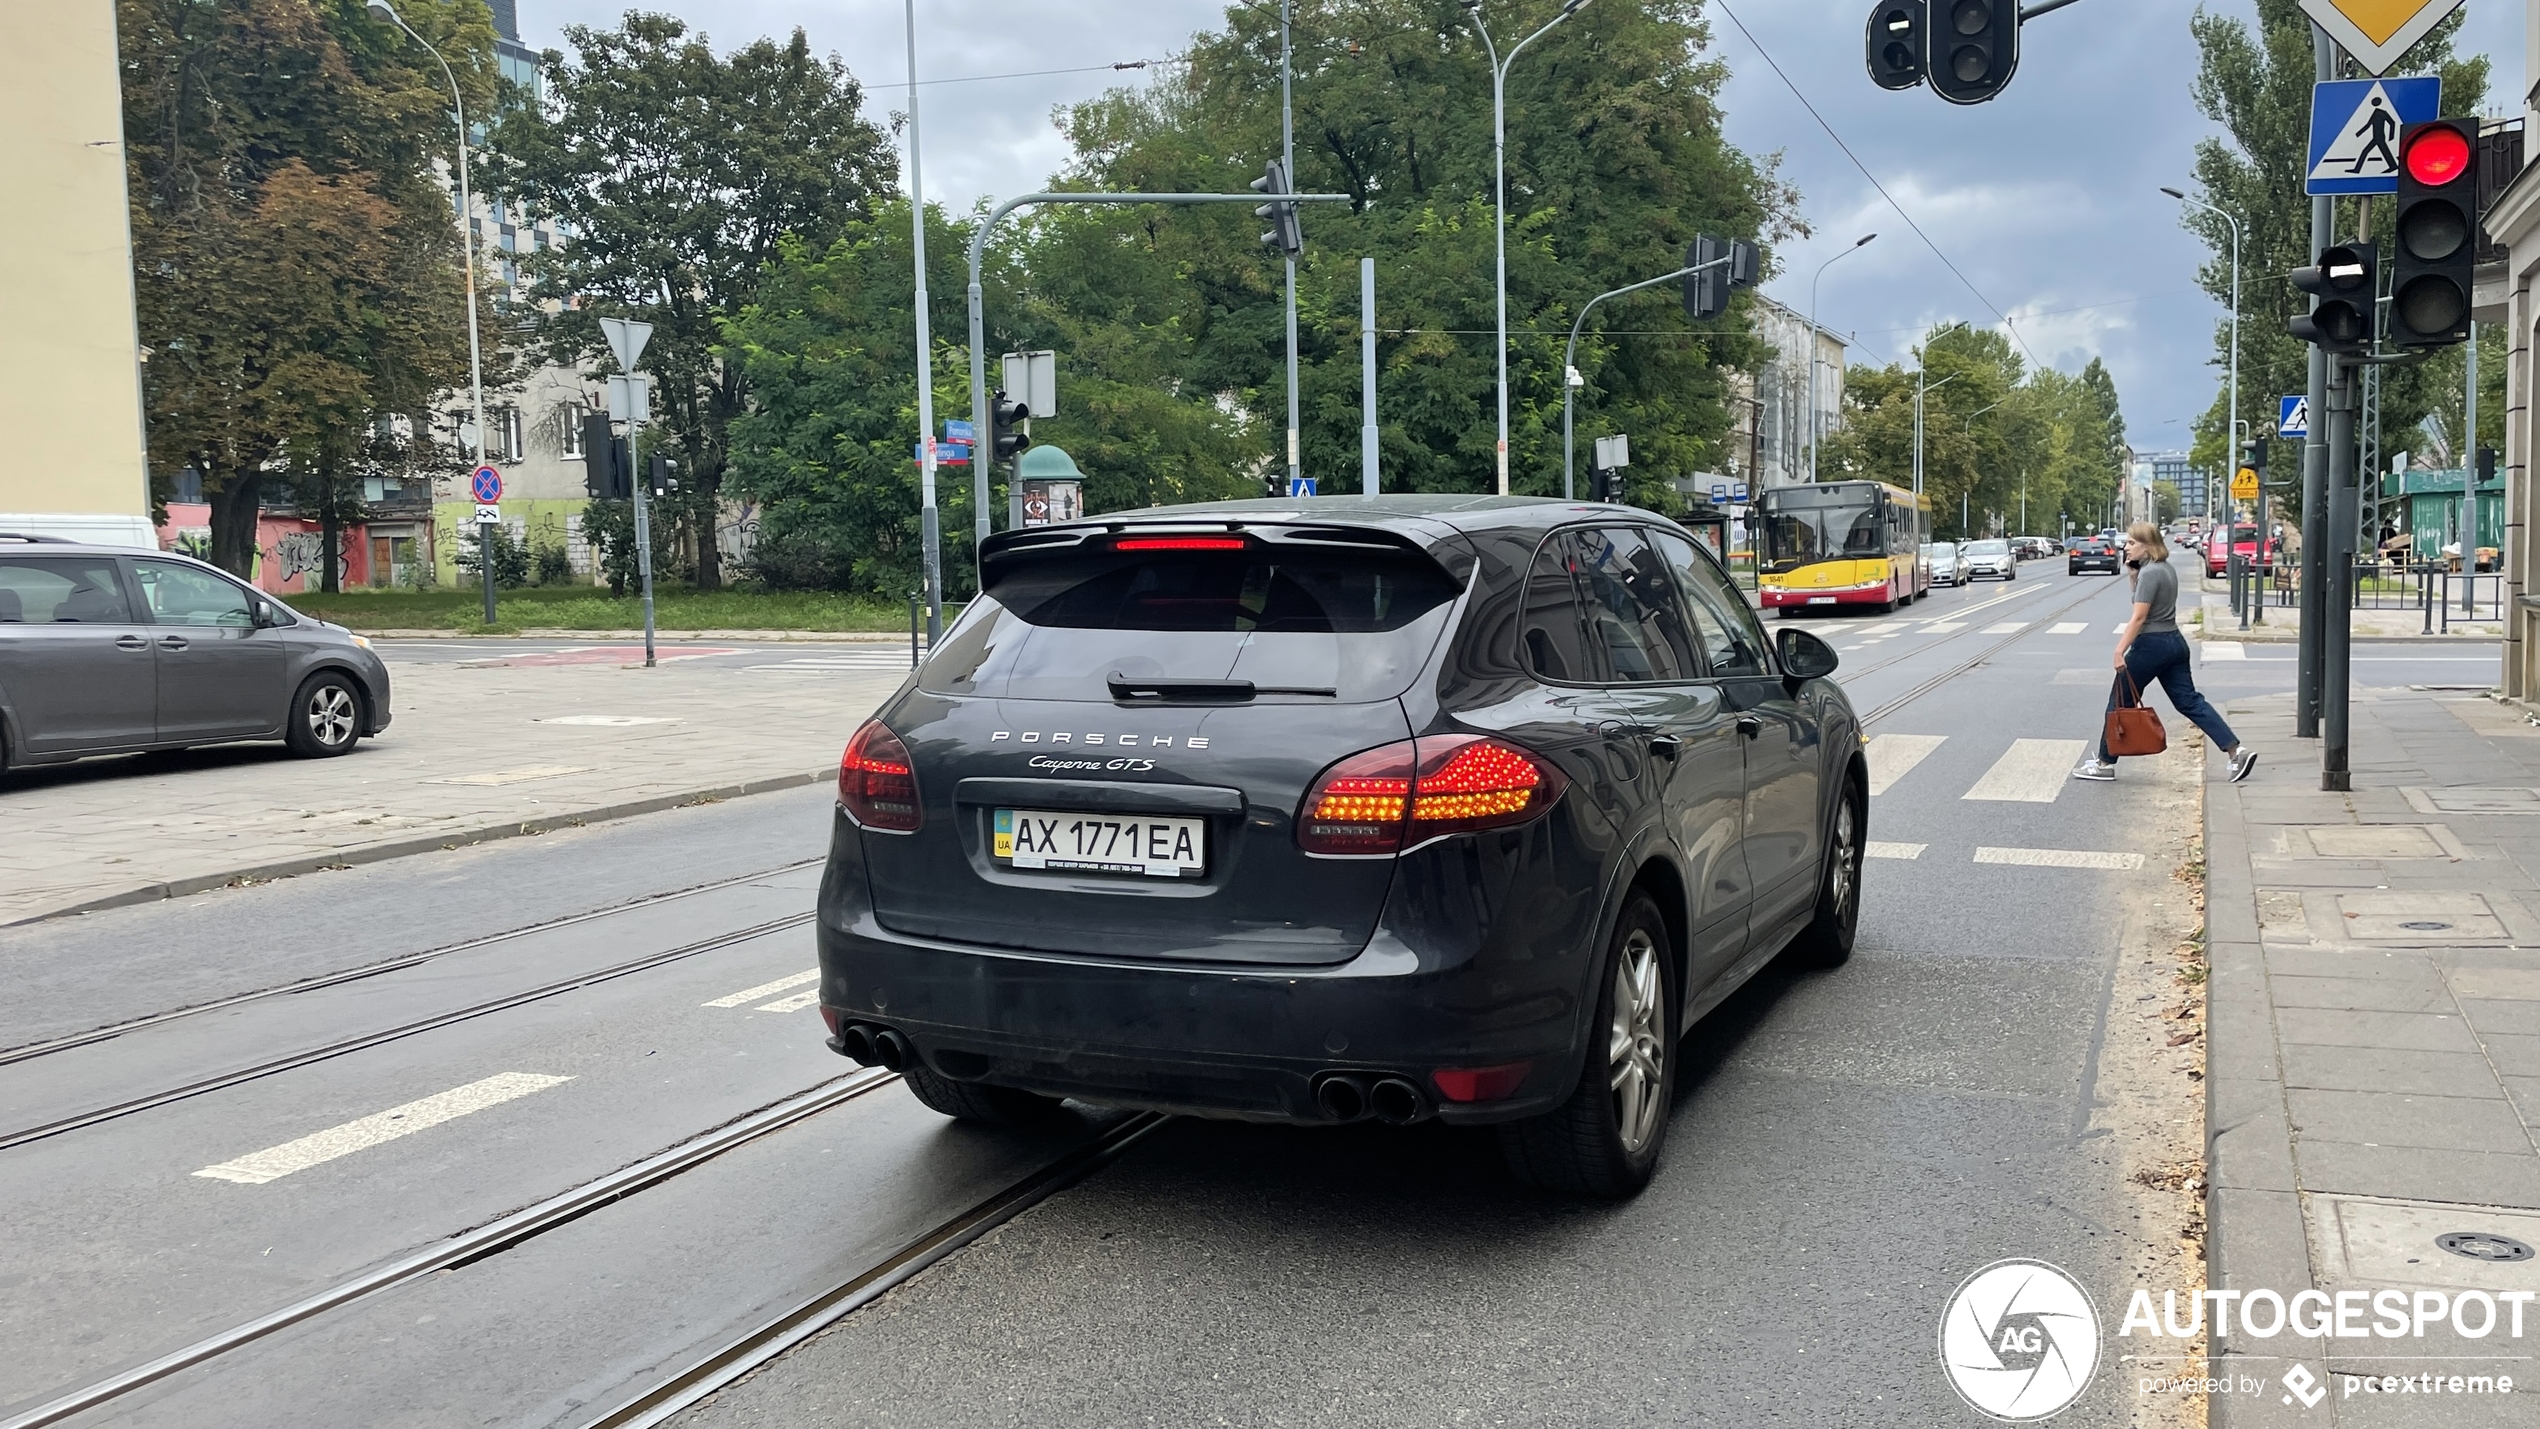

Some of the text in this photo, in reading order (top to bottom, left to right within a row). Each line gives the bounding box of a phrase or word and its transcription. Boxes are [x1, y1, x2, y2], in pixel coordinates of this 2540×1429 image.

[991, 731, 1210, 749] PORSCHE
[1028, 755, 1156, 774] Cayenne GTS
[998, 840, 1011, 849] UA
[1070, 821, 1139, 857] 1771
